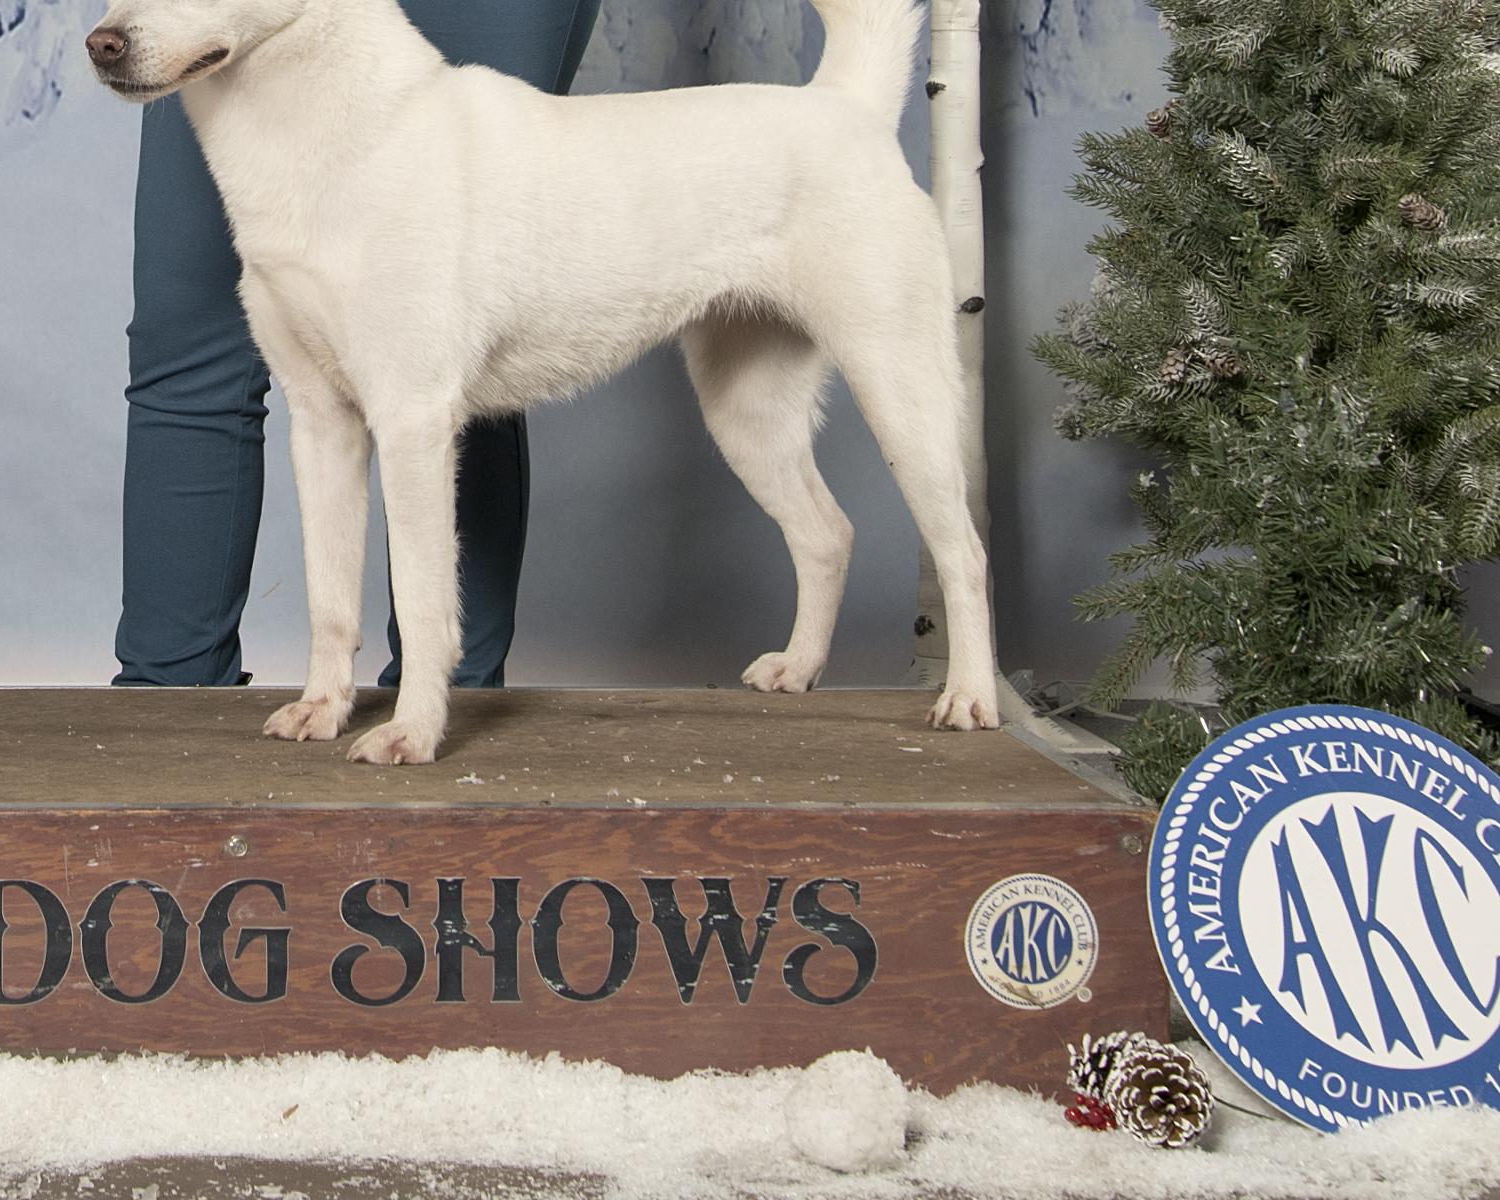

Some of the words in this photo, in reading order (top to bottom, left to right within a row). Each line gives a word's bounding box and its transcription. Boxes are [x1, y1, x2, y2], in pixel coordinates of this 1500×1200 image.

[1189, 754, 1288, 976] AMERICAN
[1288, 741, 1467, 820] KENNEL
[330, 876, 879, 1007] SHOWS
[976, 886, 1020, 950] AMERICAN
[1023, 883, 1075, 914] KENNEL
[1072, 914, 1088, 951] CLUB
[995, 903, 1069, 983] AKC
[1269, 803, 1500, 1060] AKC
[1298, 1058, 1475, 1113] FOUNDED
